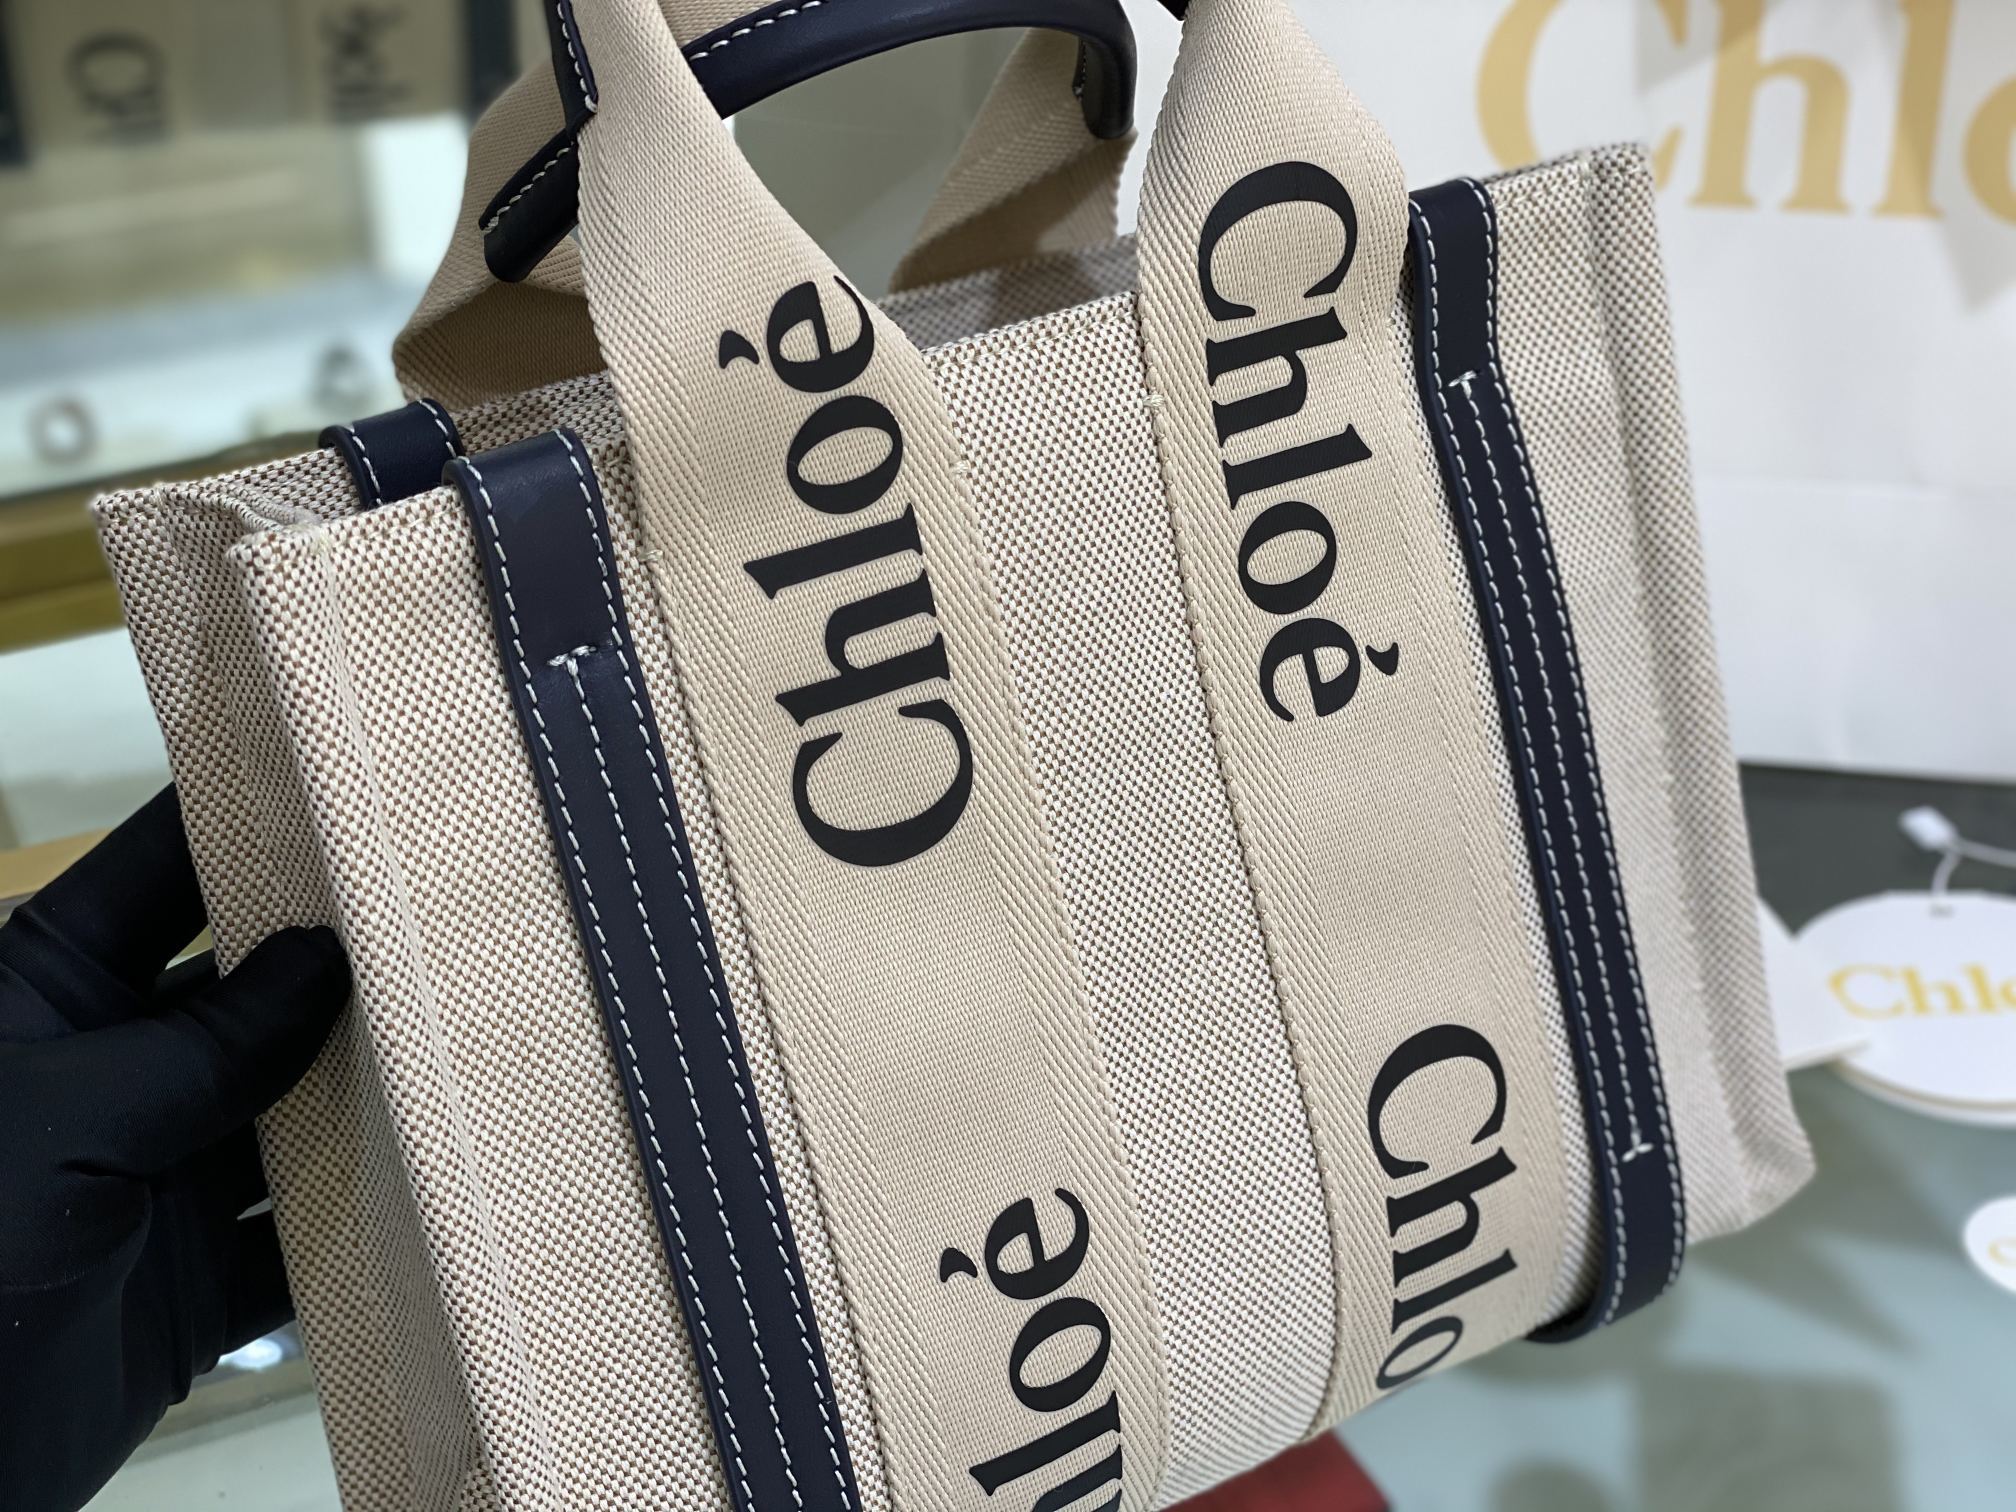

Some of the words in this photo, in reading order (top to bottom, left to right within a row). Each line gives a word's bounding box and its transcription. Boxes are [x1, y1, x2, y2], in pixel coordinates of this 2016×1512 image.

[718, 275, 974, 868] Chloé
[1197, 160, 1400, 723] Chloé
[1367, 1024, 1518, 1390] Chlo
